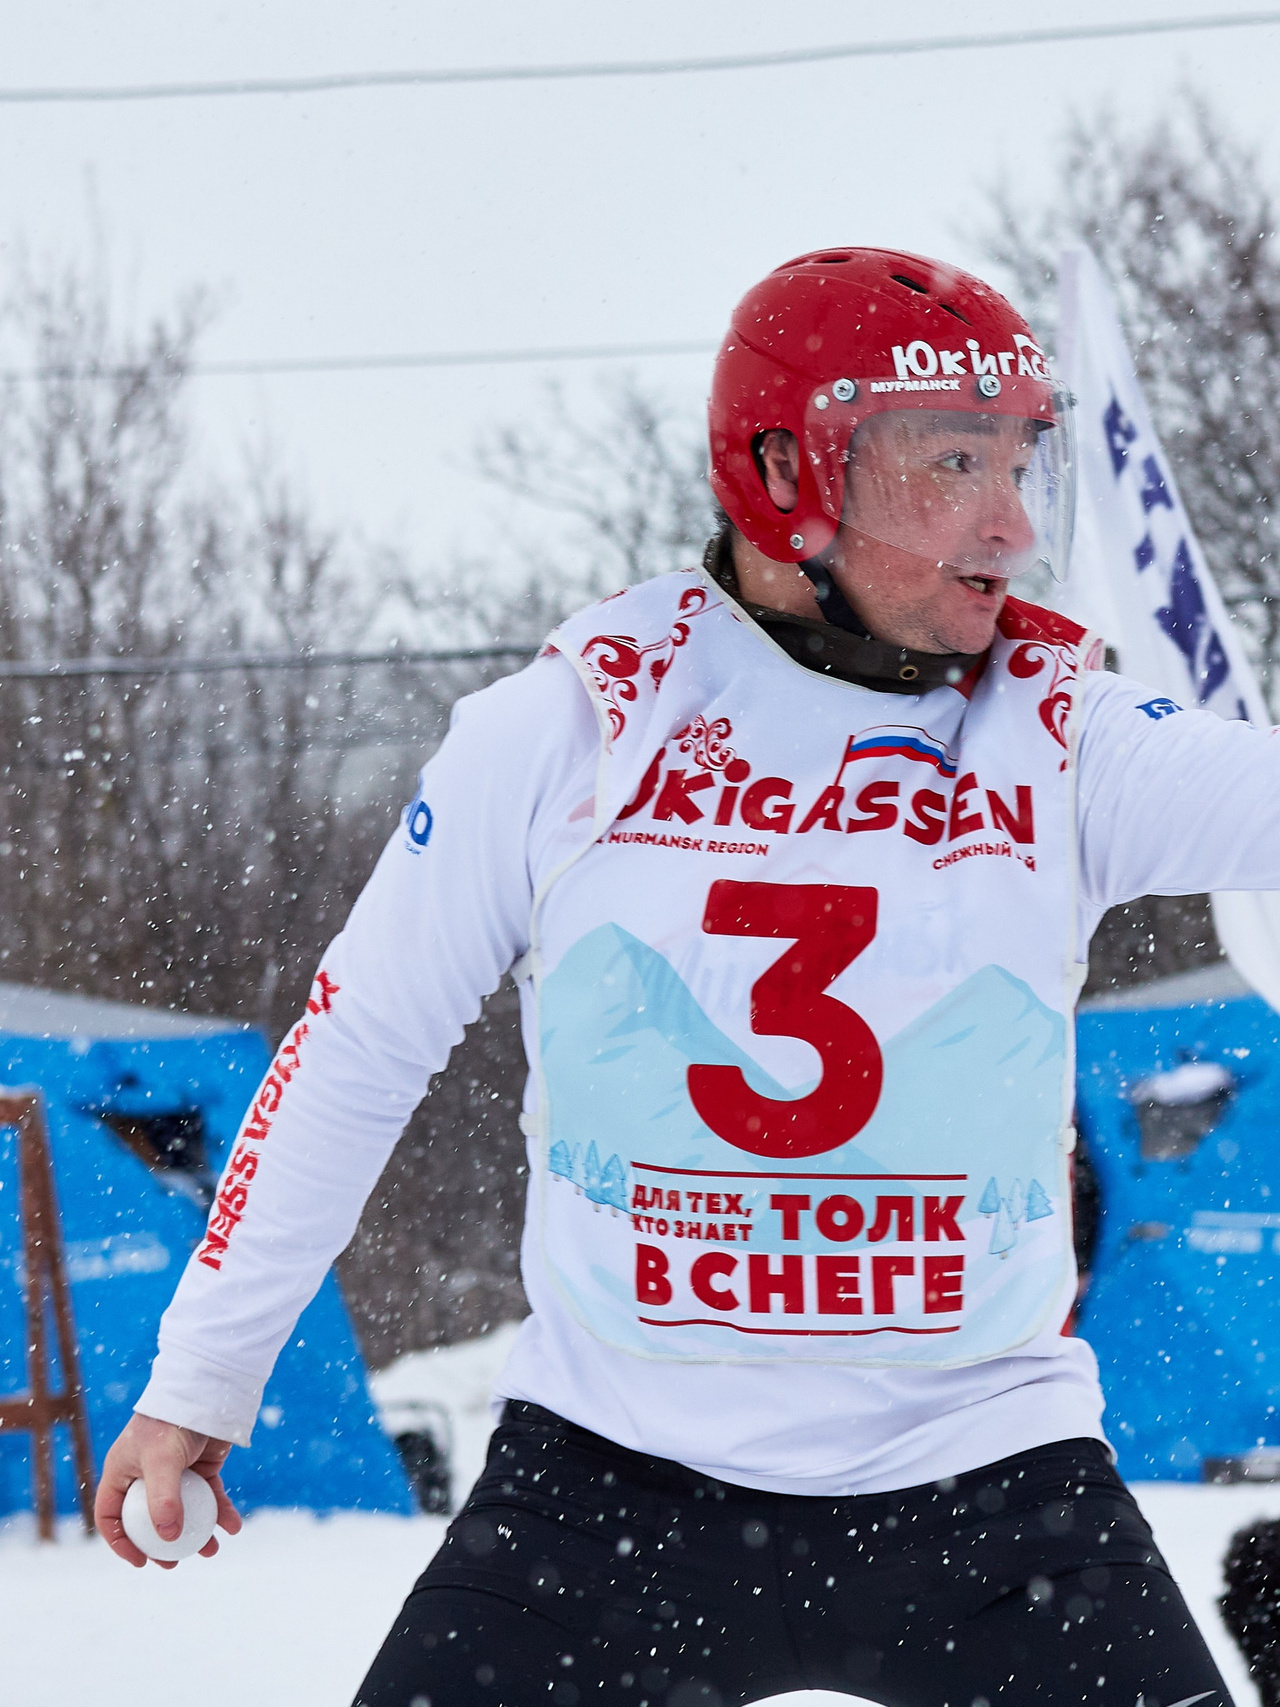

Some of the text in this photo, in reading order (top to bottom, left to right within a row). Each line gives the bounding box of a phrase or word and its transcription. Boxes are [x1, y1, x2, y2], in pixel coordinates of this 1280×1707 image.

[870, 379, 961, 393] МУРМАНСК
[608, 832, 769, 857] MURMANSK REGION
[932, 841, 1012, 870] СНЕЖНЫЙ
[687, 880, 884, 1158] 3
[632, 1184, 754, 1218] ДЛЯ ТЕХ,
[631, 1213, 754, 1242] КТО ЗНАЕТ
[770, 1194, 966, 1243] ТОЛК
[635, 1243, 965, 1316] В СНЕГЕ
